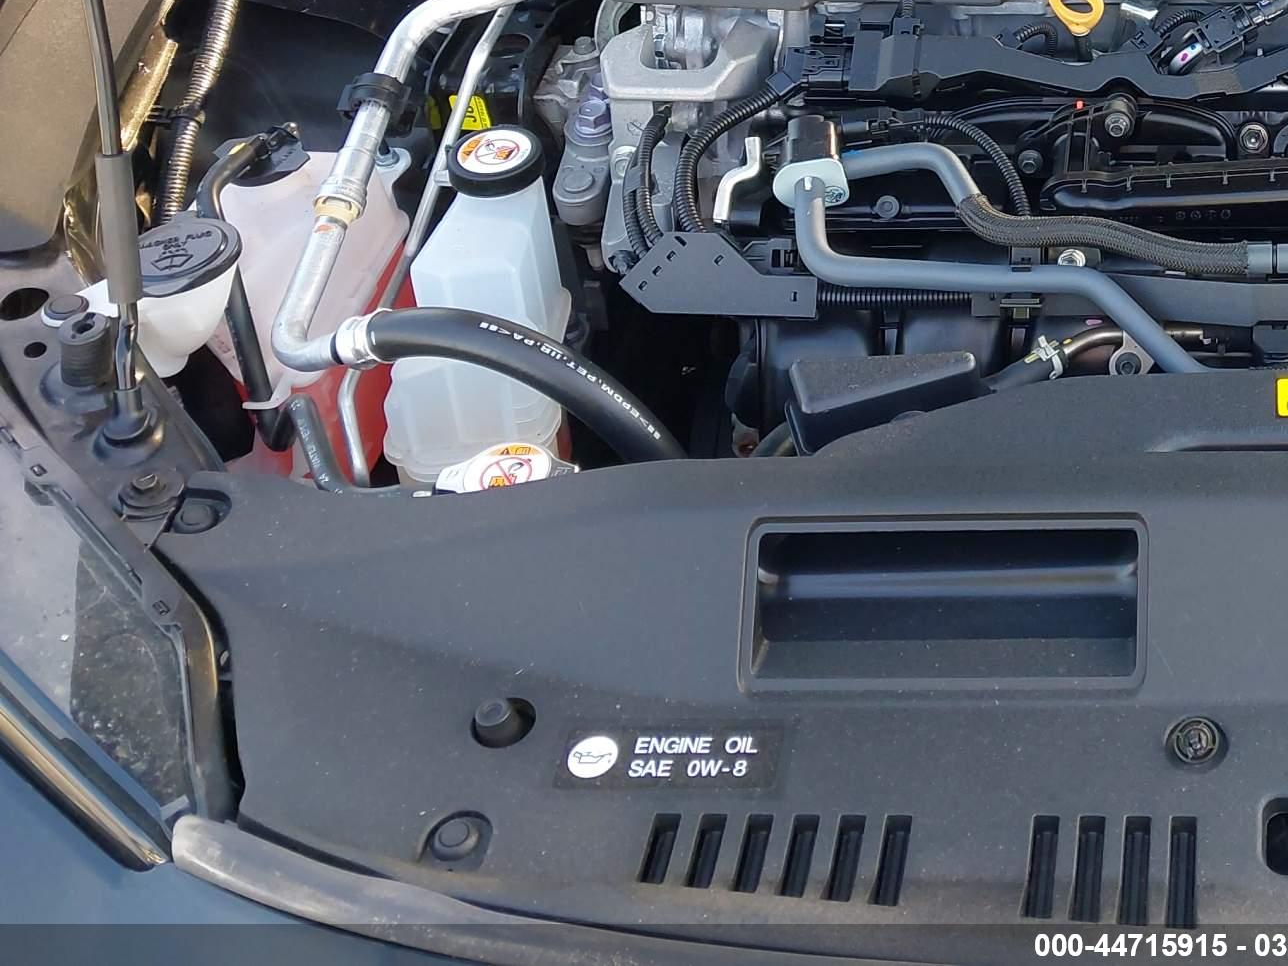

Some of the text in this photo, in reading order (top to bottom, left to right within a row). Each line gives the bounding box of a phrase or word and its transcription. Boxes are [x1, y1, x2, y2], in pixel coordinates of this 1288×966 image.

[634, 737, 758, 754] ENGINE OIL
[628, 760, 748, 777] SAE 0W-8
